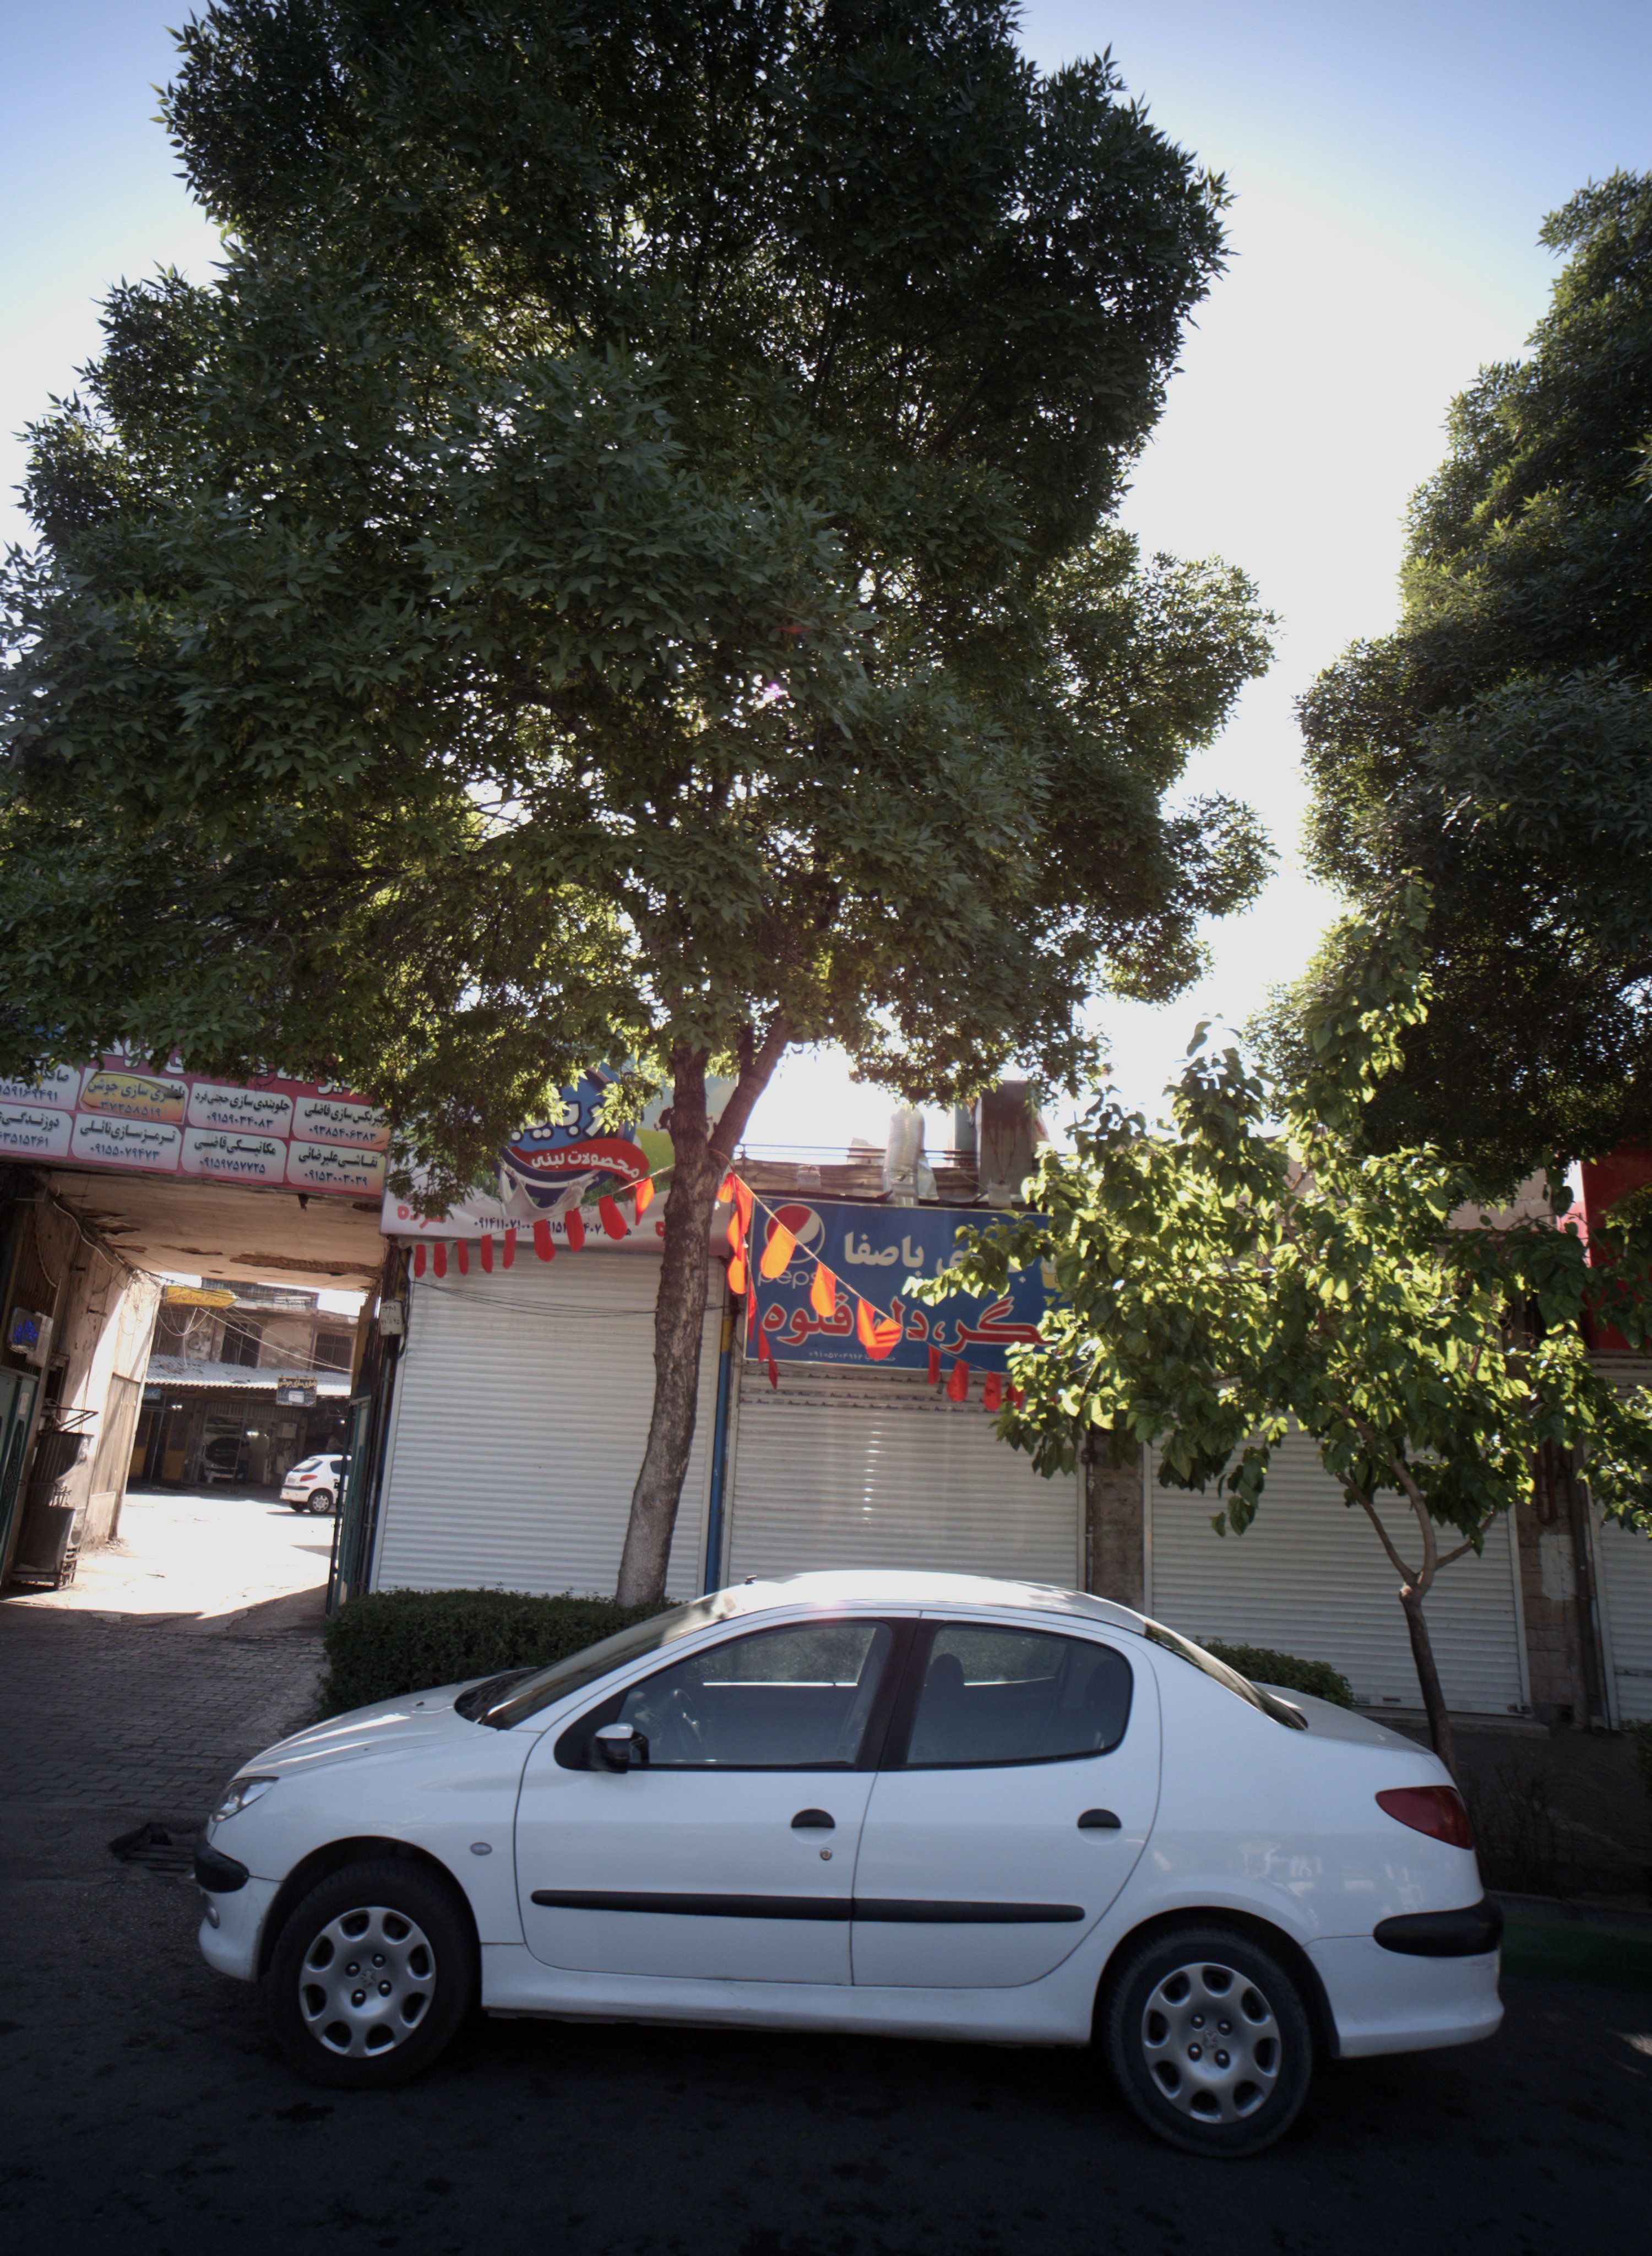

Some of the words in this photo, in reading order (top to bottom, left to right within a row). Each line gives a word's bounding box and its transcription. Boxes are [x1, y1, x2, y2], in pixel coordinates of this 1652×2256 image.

[87, 1078, 118, 1096] جوشن
[121, 1083, 149, 1098] سازی
[195, 1091, 208, 1103] فرد
[230, 1095, 253, 1109] سازی
[253, 1099, 290, 1115] جلوبندی
[305, 1103, 330, 1117] فاضلی
[330, 1107, 352, 1121] سازی
[2, 1111, 59, 1131] دوزندگی
[111, 1124, 142, 1140] سازی
[140, 1130, 177, 1145] ترمز
[194, 1136, 227, 1149] قاضی
[227, 1139, 276, 1157] مکانیکی
[90, 1143, 160, 1159] ۰۹۱۵۵۰۷۹۴۷۳
[199, 1157, 266, 1174] ۰۹۱۵۹۷۵۷۷۲۵
[338, 1154, 378, 1168] نقاشی
[531, 1152, 565, 1168] لبنی
[567, 1151, 640, 1178] محصولات
[844, 1230, 925, 1278] باصفا
